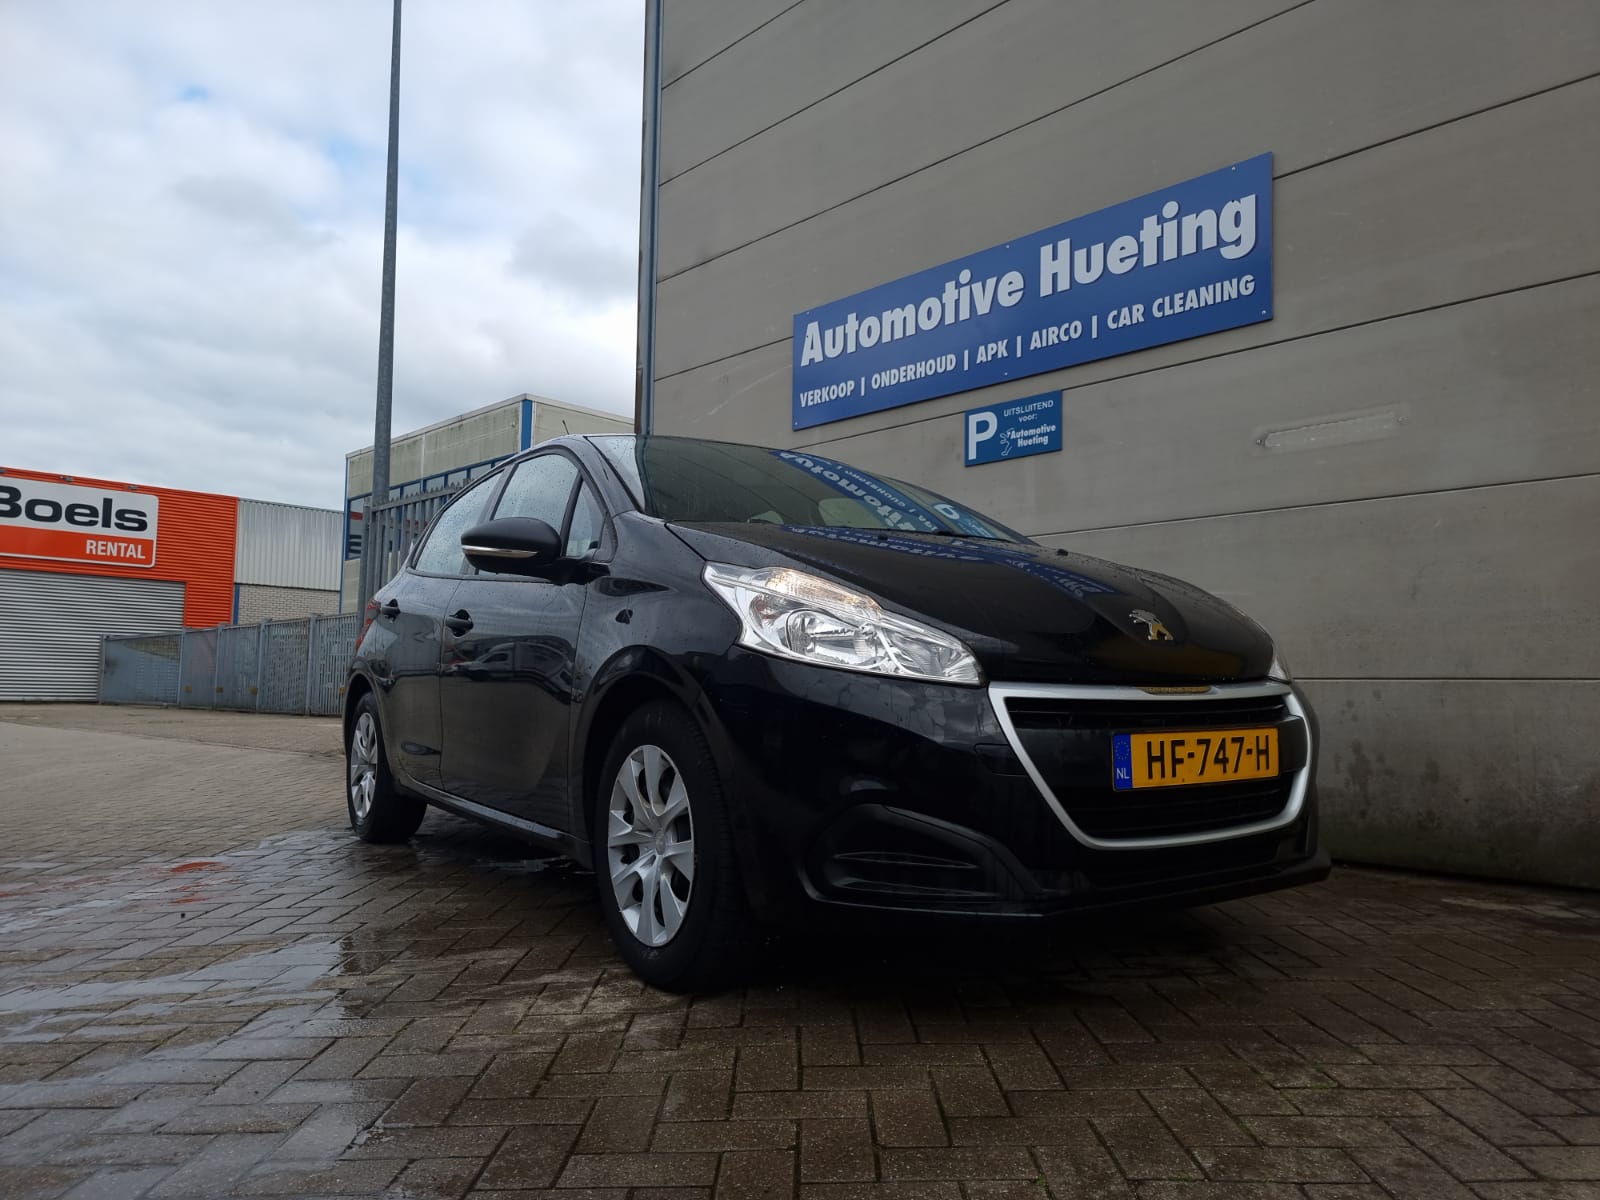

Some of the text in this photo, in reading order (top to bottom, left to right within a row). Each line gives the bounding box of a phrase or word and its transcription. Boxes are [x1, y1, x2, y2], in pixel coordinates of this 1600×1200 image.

[801, 193, 1257, 367] Automotive Hueting
[799, 380, 855, 408] VERKOOP
[871, 353, 957, 390] ONDERHOUD
[975, 338, 1009, 364] APK
[1029, 320, 1082, 350] AIRCO
[1107, 303, 1145, 330] CAR
[1152, 274, 1256, 318] CLEANING
[1003, 399, 1054, 417] UITSLUITEND
[968, 411, 998, 461] P
[1010, 423, 1057, 440] Automotive
[1017, 434, 1049, 448] Hueting
[86, 539, 146, 559] RENTAL
[1146, 734, 1271, 780] HF-747-H
[1116, 767, 1130, 780] NL
